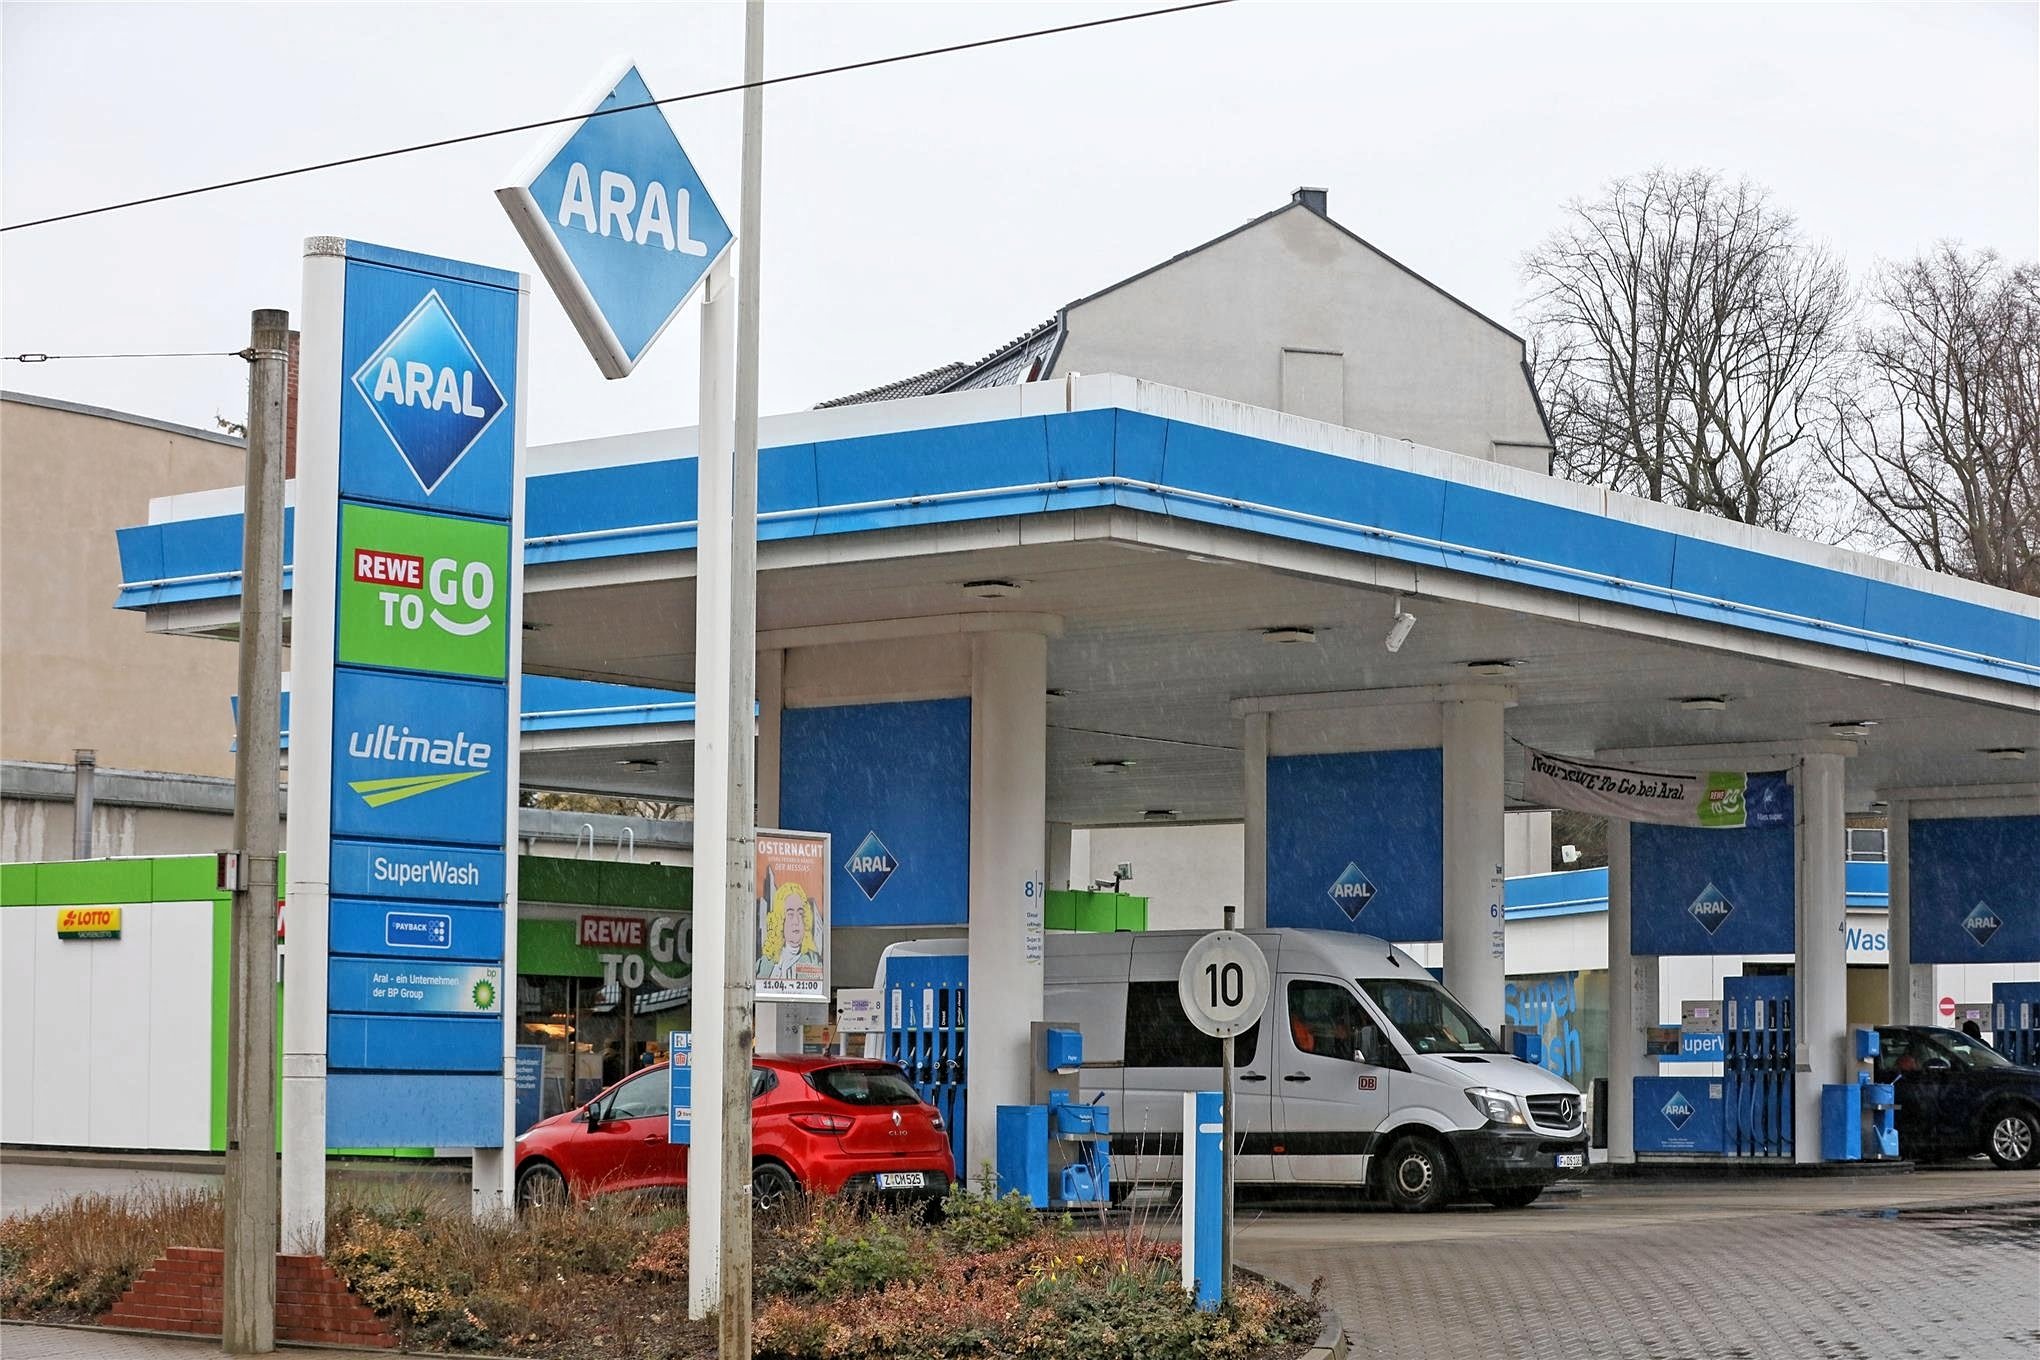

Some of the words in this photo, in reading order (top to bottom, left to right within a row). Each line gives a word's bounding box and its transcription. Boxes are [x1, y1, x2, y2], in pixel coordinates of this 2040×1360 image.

[558, 162, 708, 257] ARAL
[374, 357, 486, 418] ARAL
[358, 553, 420, 585] REWE
[429, 558, 495, 610] GO
[379, 592, 424, 629] TO
[349, 724, 491, 768] ultimate
[1599, 776, 1616, 792] To
[1618, 778, 1636, 794] Go
[1636, 780, 1657, 797] bei
[1657, 782, 1684, 800] Aral.
[758, 841, 823, 857] OSTERNACHT
[374, 857, 479, 886] SuperWash
[852, 856, 890, 873] ARAL
[1025, 881, 1034, 897] 8
[1038, 882, 1043, 898] 7
[1334, 883, 1370, 898] ARAL
[1490, 904, 1498, 918] 6
[1694, 901, 1727, 914] ARAL
[78, 911, 110, 925] LOTTO
[1967, 916, 1997, 929] ARAL
[395, 922, 427, 932] PAYBACK
[1838, 921, 1844, 934] 4
[583, 920, 643, 944] REWE
[650, 916, 692, 964] GO
[1845, 928, 1890, 951] Was
[487, 968, 496, 978] bp
[600, 954, 644, 988] TO
[373, 973, 389, 984] Aral
[396, 974, 407, 984] ein
[409, 974, 459, 986] Unternehmen
[763, 981, 787, 991] 11.04.
[796, 981, 818, 990] 21:00
[1205, 962, 1243, 1007] 10
[372, 988, 385, 997] der
[388, 988, 398, 997] BP
[400, 988, 423, 999] Group
[876, 1001, 881, 1010] 8
[1504, 971, 1577, 1035] Super
[1682, 1036, 1724, 1055] uper
[1361, 1079, 1375, 1089] DB
[1666, 1105, 1690, 1115] ARAL
[884, 1174, 891, 1185] Z
